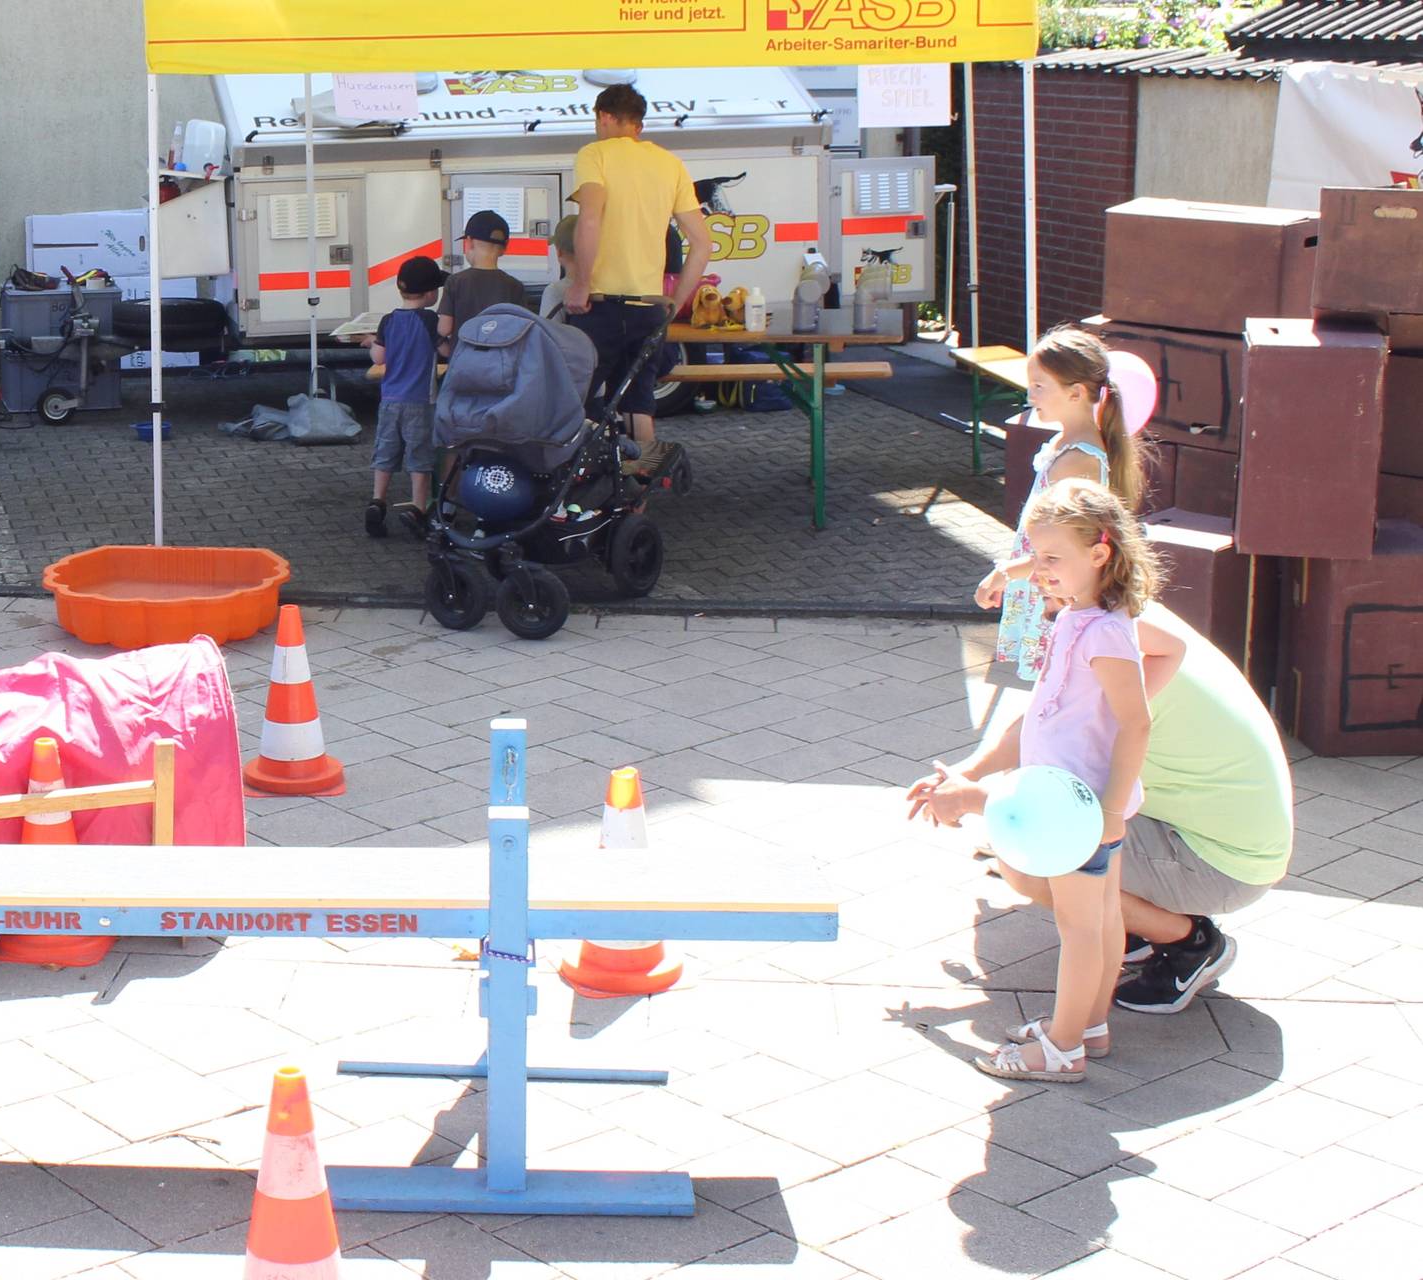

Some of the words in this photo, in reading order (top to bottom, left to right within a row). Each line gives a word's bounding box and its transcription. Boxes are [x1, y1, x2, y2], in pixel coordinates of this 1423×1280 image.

[619, 8, 649, 20] hier
[654, 7, 683, 20] und
[688, 6, 726, 22] jetzt.
[765, 35, 957, 51] Arbeiter-Samariter-Bund
[482, 75, 578, 94] ASB
[651, 100, 696, 112] RV
[160, 911, 312, 932] STANDORT
[325, 913, 418, 933] ESSEN
